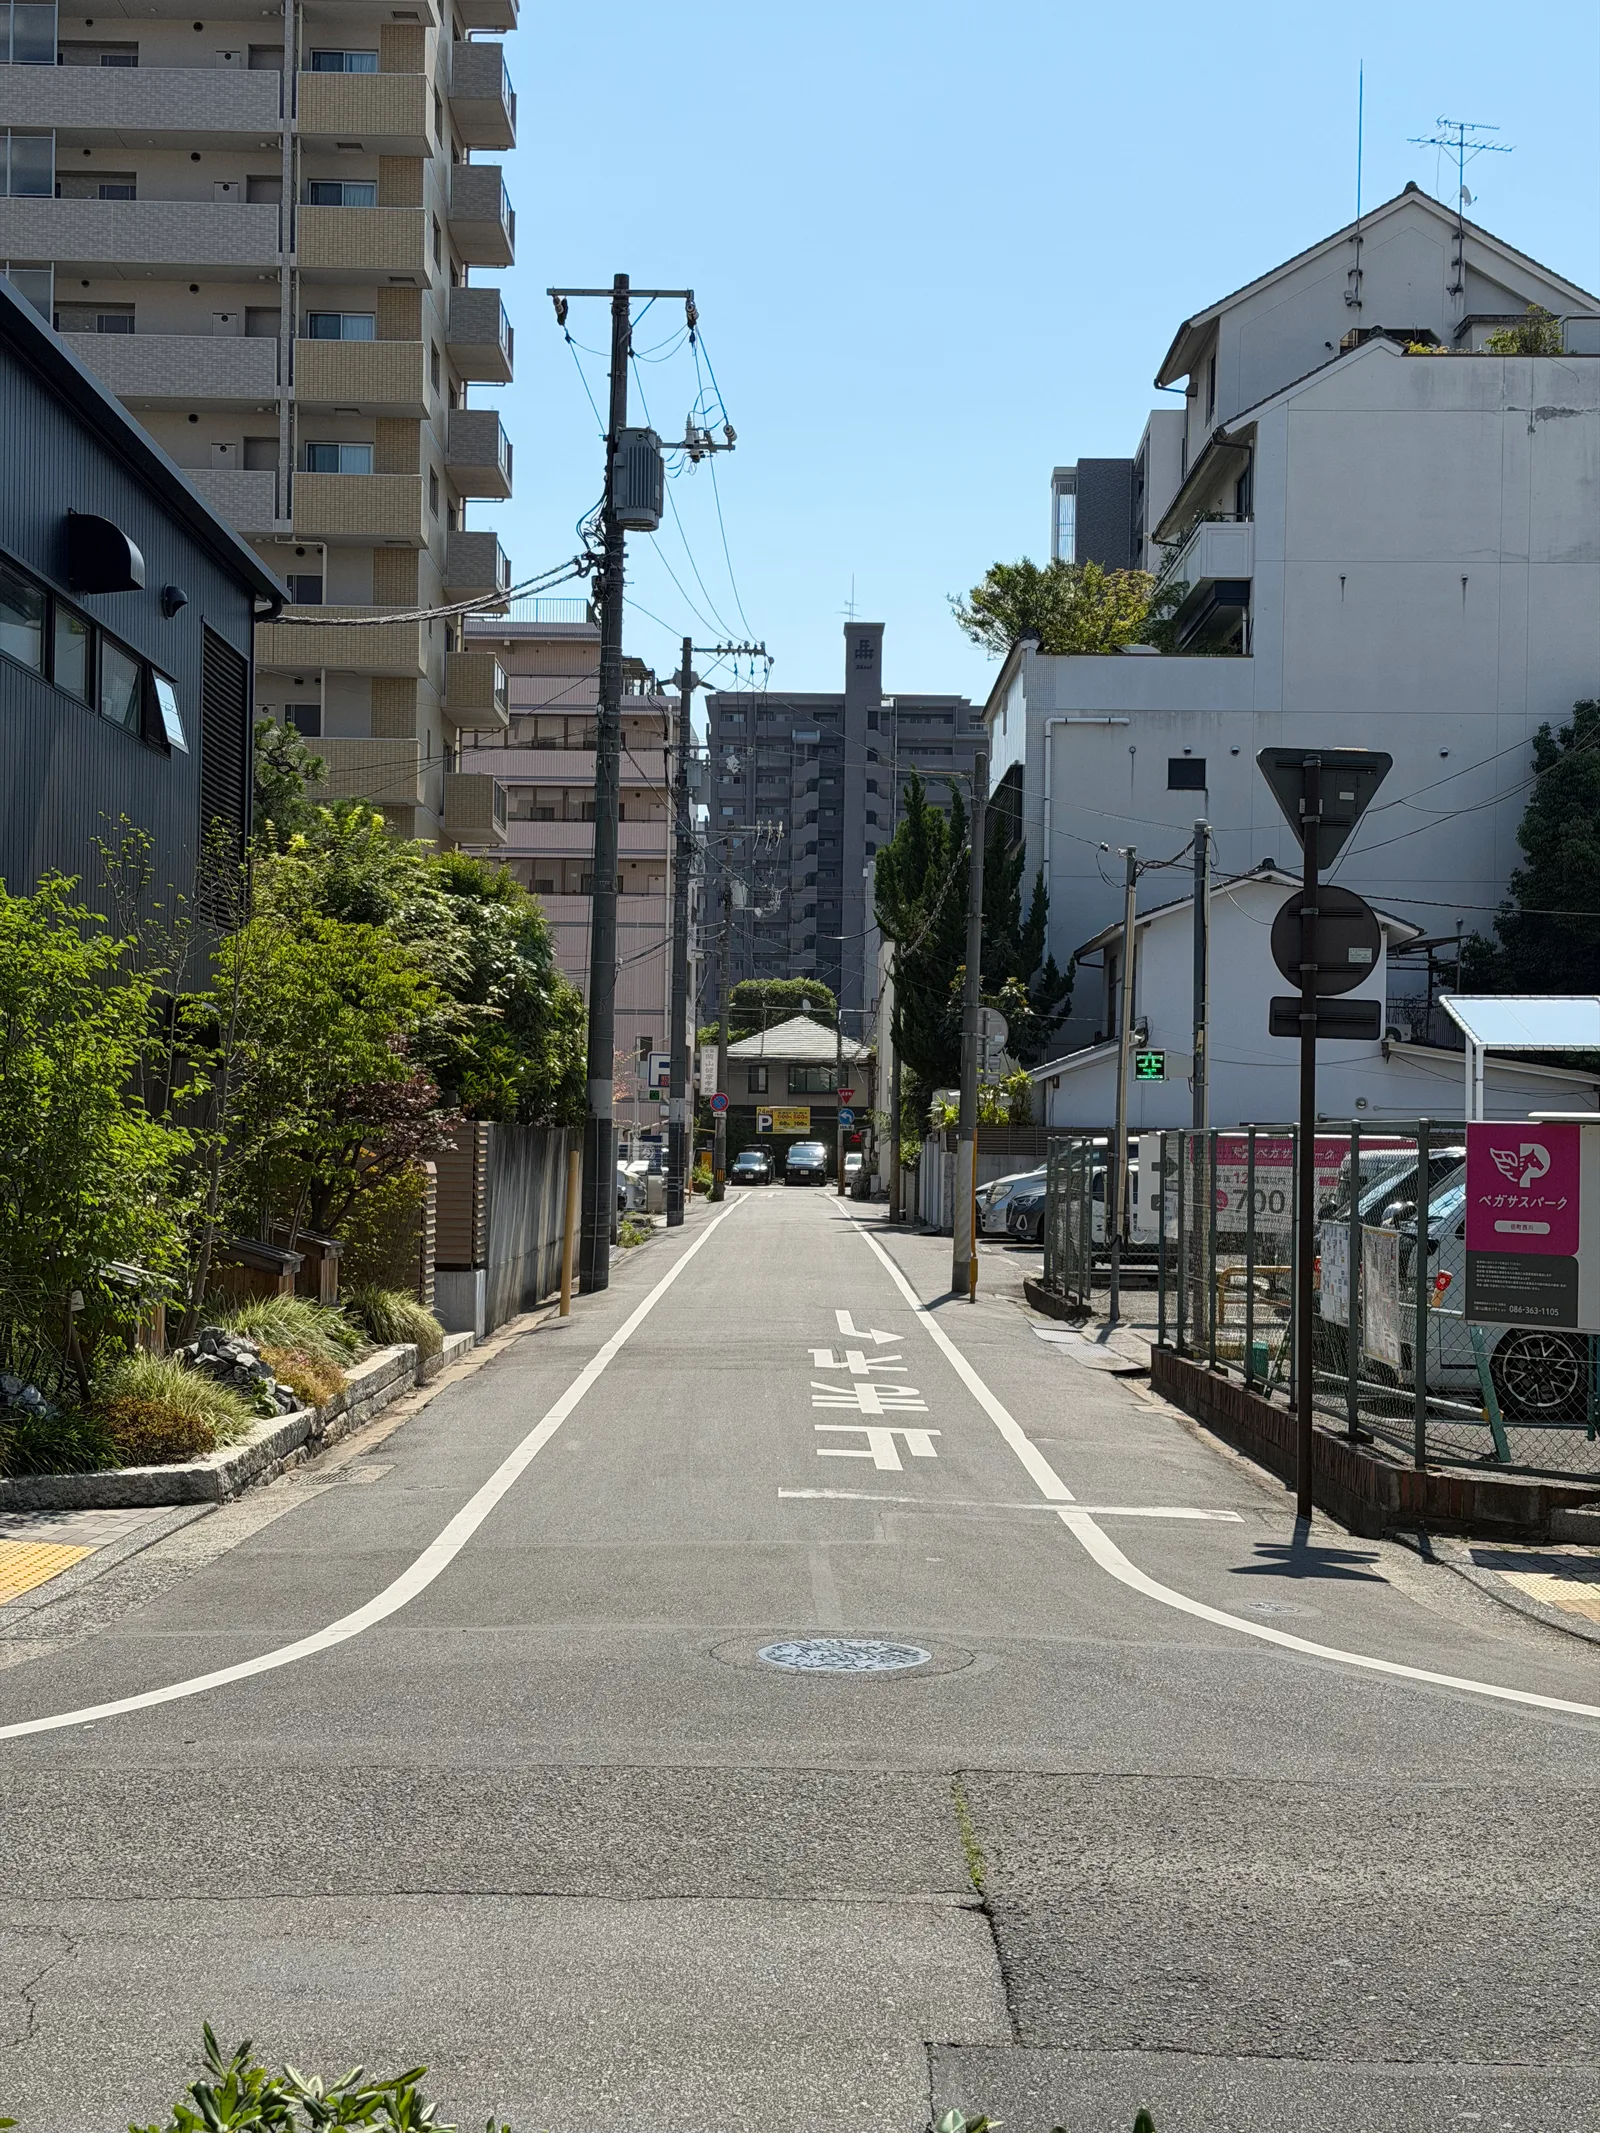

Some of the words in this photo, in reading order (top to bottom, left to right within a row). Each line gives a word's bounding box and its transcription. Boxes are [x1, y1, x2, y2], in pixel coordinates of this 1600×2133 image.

[1136, 1051, 1164, 1079] 空
[758, 1115, 773, 1132] P
[1478, 1194, 1568, 1211] ペガサスパーク
[1508, 1304, 1560, 1317] 086-363-1105
[808, 1349, 942, 1470] 止まれ
